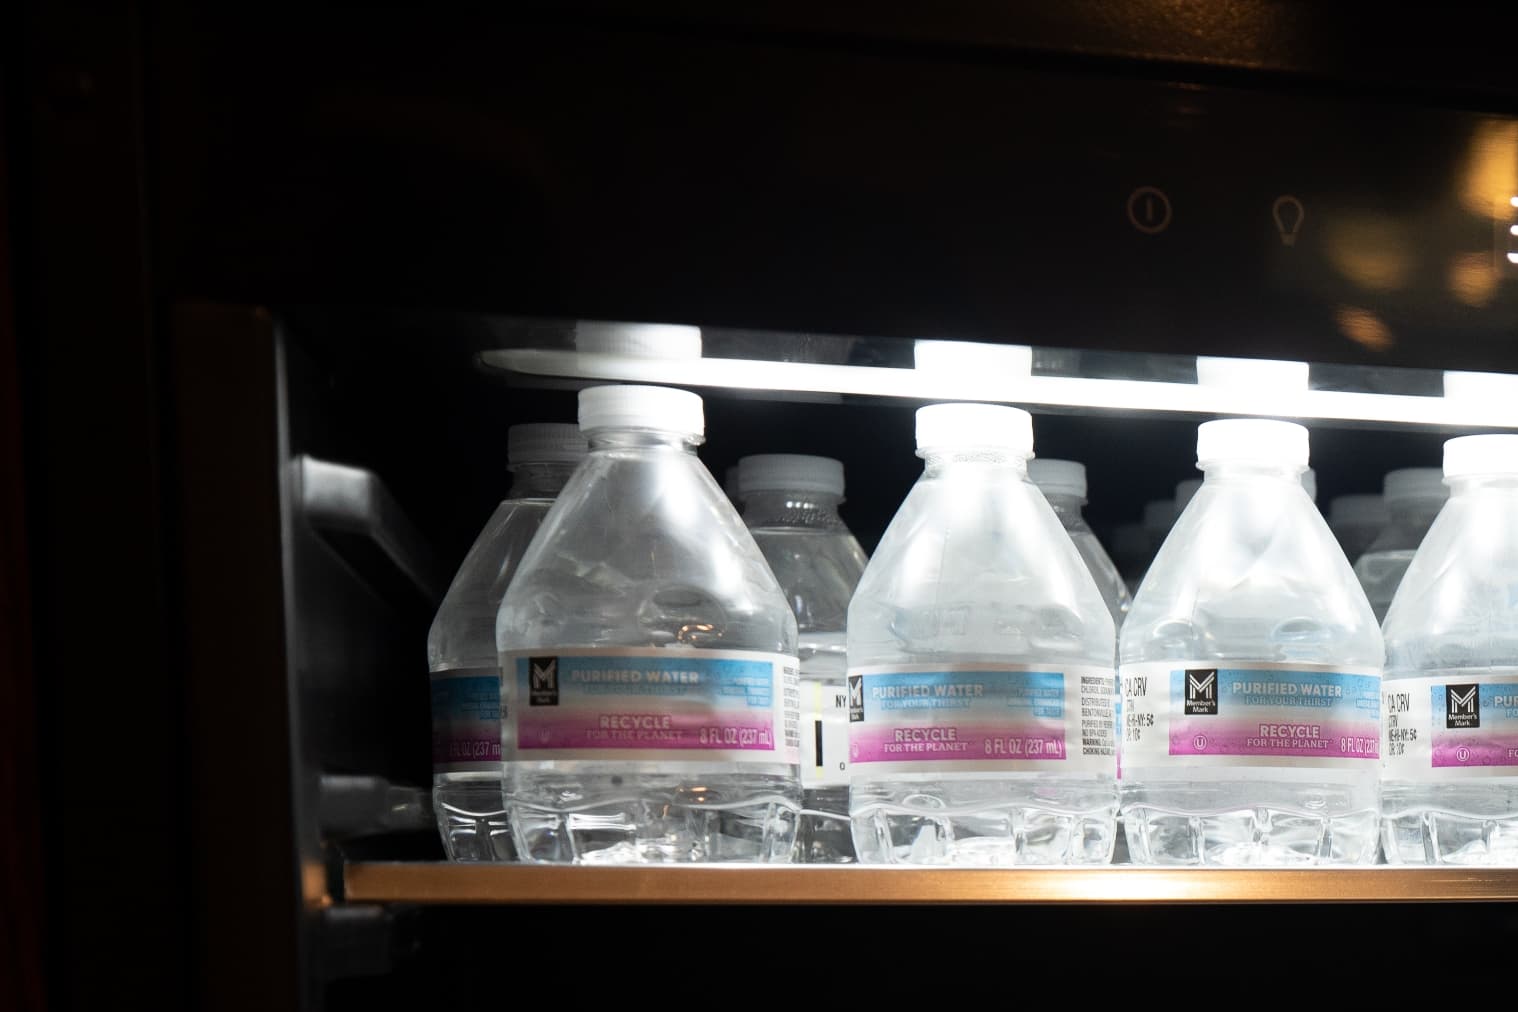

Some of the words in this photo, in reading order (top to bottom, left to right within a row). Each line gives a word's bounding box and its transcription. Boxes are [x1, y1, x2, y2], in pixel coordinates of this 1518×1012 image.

[571, 670, 642, 683] PURIFIED
[646, 671, 699, 684] WATER
[872, 685, 930, 698] PURIFIED
[933, 684, 983, 697] WATER
[1133, 676, 1148, 697] CRV
[1232, 682, 1298, 695] PURIFIED
[1300, 683, 1342, 697] WATER
[1396, 692, 1410, 712] CRV
[599, 715, 671, 730] RECYCLE
[1146, 713, 1155, 727] 5¢
[699, 727, 708, 744] 8
[709, 727, 722, 744] FL
[724, 728, 738, 745] OZ
[738, 728, 757, 747] (237
[758, 728, 772, 747] mL)
[895, 727, 957, 742] RECYCLE
[1260, 725, 1320, 738] RECYCLE
[1409, 728, 1417, 742] 5¢
[884, 743, 902, 753] FOR
[903, 743, 924, 752] THE
[926, 742, 969, 752] PLANET
[984, 739, 992, 754] 8
[994, 739, 1006, 754] FL
[1008, 739, 1021, 754] OZ
[1024, 739, 1043, 757] (237
[1046, 740, 1063, 758] mL)
[1247, 739, 1269, 748] FOR
[1271, 739, 1290, 748] THE
[1292, 739, 1329, 749] PLANET
[1341, 738, 1346, 753] 8
[1347, 738, 1355, 753] FL
[1356, 739, 1364, 753] OZ
